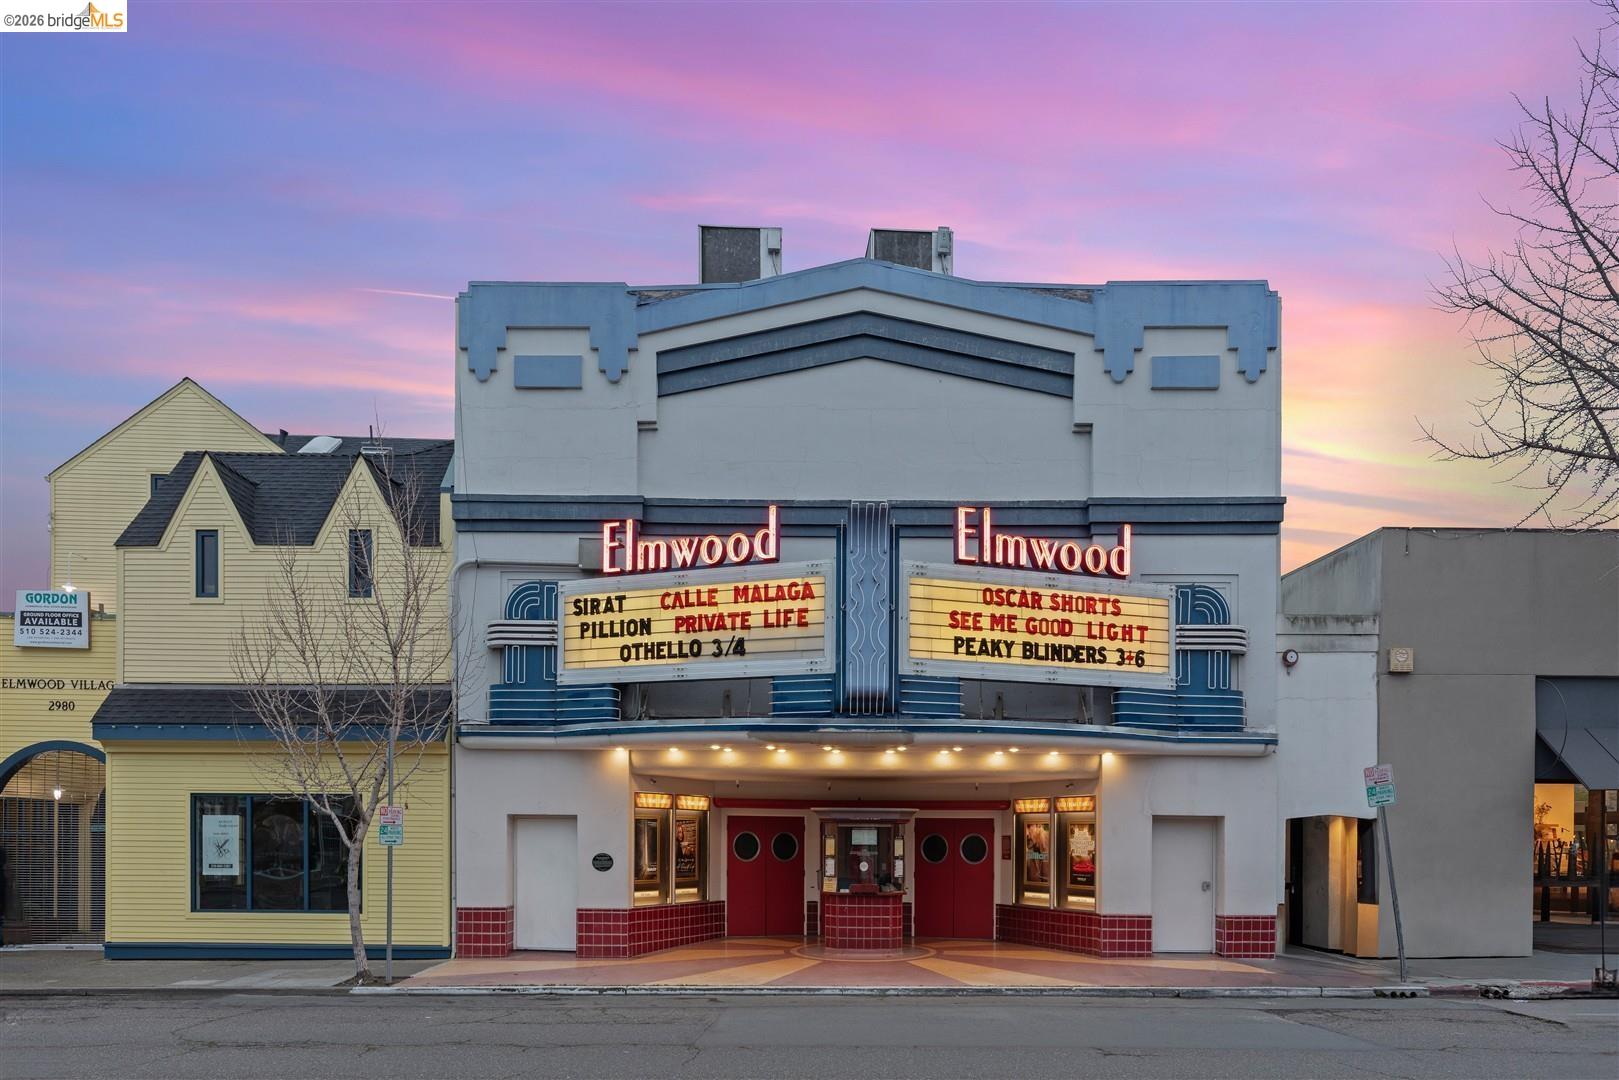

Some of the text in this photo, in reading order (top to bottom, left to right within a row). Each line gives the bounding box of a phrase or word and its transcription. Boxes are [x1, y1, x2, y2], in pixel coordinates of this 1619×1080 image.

[602, 505, 780, 576] Elmwood
[954, 506, 1132, 579] Elmwood
[26, 593, 77, 604] GORDON
[573, 594, 626, 617] SIRAT
[660, 581, 816, 611] CALLE MALAGA
[982, 587, 1122, 617] OSCAR SHORTS
[24, 617, 78, 626] AVAILABLE
[39, 628, 82, 636] 524-2344
[580, 617, 652, 639] PILLION
[674, 607, 809, 634] PRIVATE LIFE
[948, 610, 1149, 644] SEE ME GOOD LIGHT
[619, 635, 746, 662] OTHELLO 3/4
[953, 635, 1015, 659] PEAKY
[1022, 640, 1107, 664] BLINDERS
[2, 678, 65, 690] ELMWOOD
[48, 700, 75, 711] 2980
